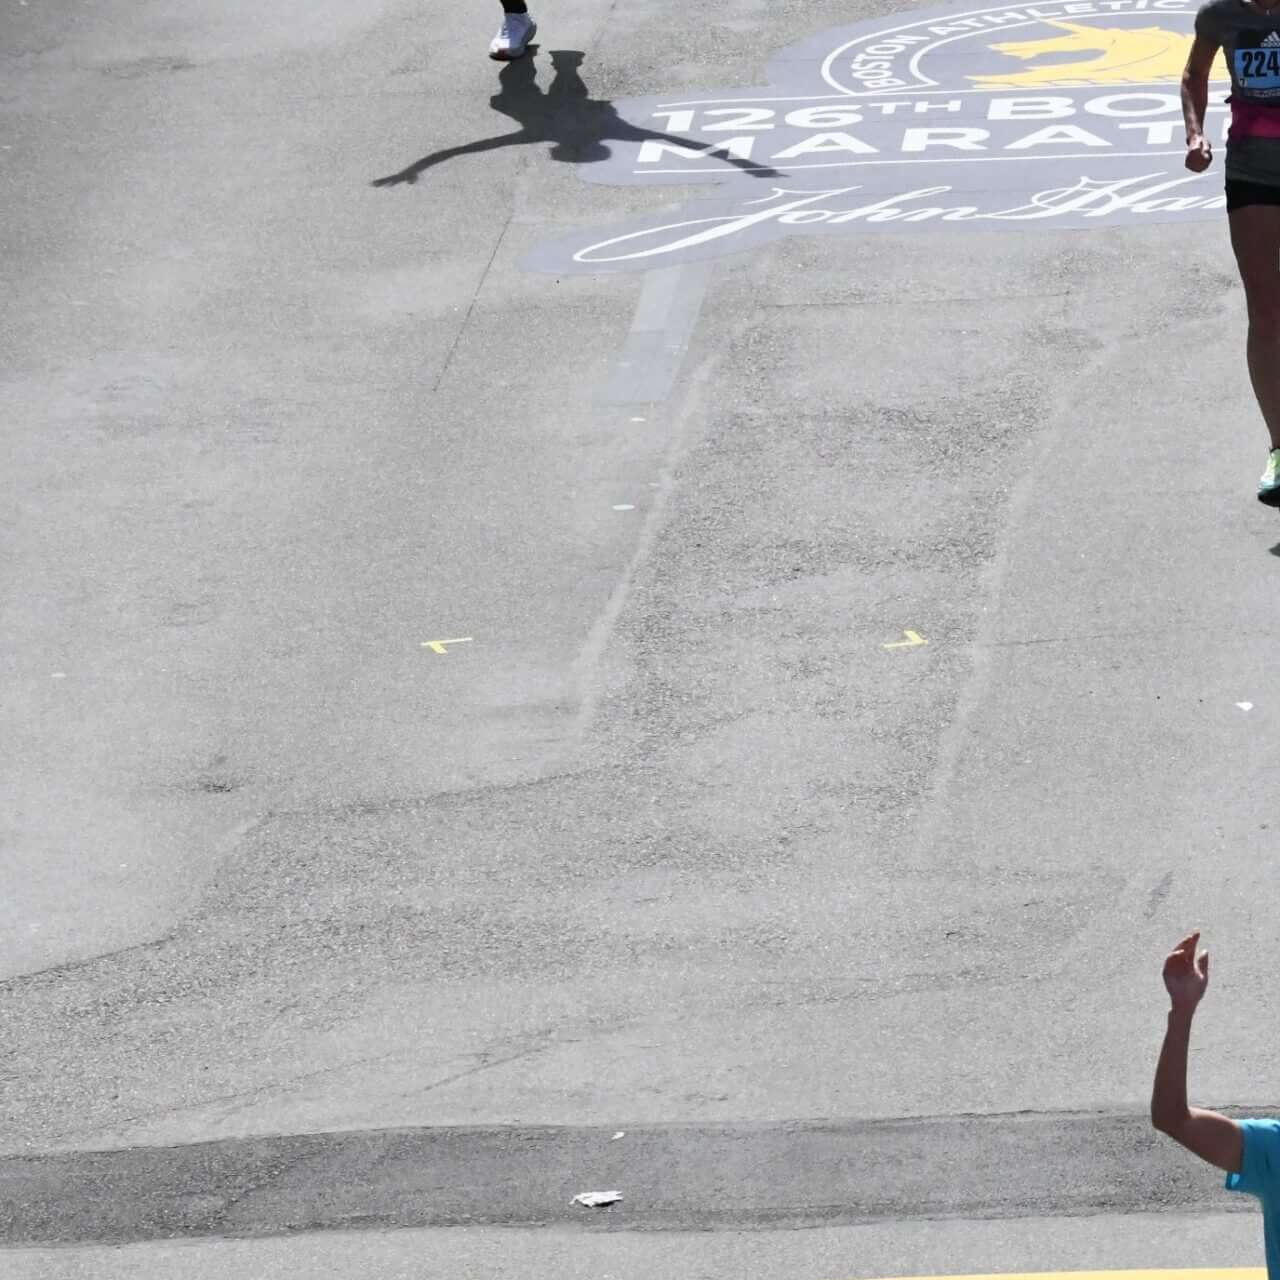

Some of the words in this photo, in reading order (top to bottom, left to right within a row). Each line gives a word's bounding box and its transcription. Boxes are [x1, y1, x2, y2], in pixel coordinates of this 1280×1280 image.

[851, 34, 930, 90] BOSTON
[652, 99, 962, 133] 126TH
[573, 185, 985, 262] John
